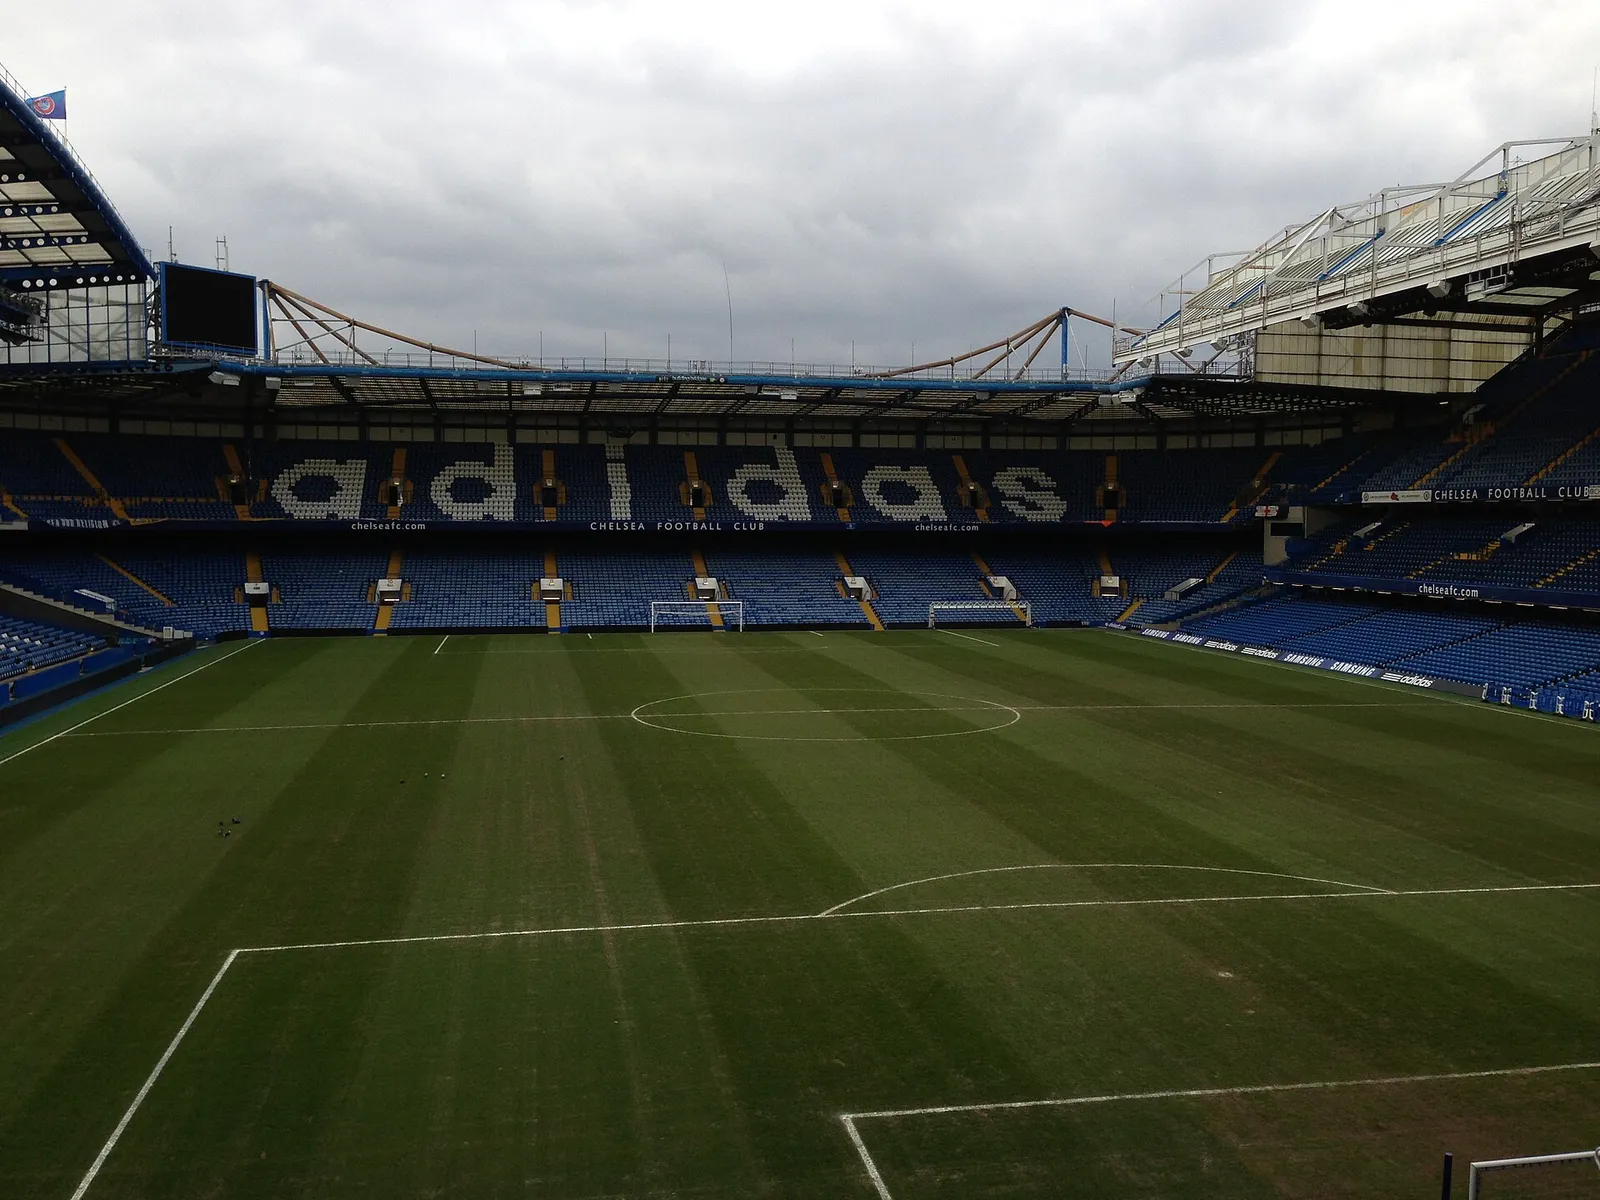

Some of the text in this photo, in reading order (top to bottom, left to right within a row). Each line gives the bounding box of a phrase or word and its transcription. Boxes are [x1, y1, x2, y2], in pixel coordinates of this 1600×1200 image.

[270, 442, 1067, 522] adidas
[1434, 489, 1478, 500] CHELSEA
[1488, 487, 1547, 499] FOOTBALL
[1558, 486, 1590, 498] CLUB
[351, 521, 426, 530] chelseafc.com
[590, 522, 765, 531] CHELSEA FOOTBALL CLUB
[915, 523, 979, 531] chelseafc.com
[1418, 583, 1479, 597] chelseafc.com
[1141, 628, 1170, 639] SAMSUNG
[1172, 633, 1203, 645] SAMSUNG
[1216, 641, 1239, 651] adidas
[1254, 646, 1279, 659] adidas
[1283, 653, 1324, 667] SAMSUNG
[1330, 661, 1376, 677] SAMSUNG
[1399, 674, 1434, 688] adidas
